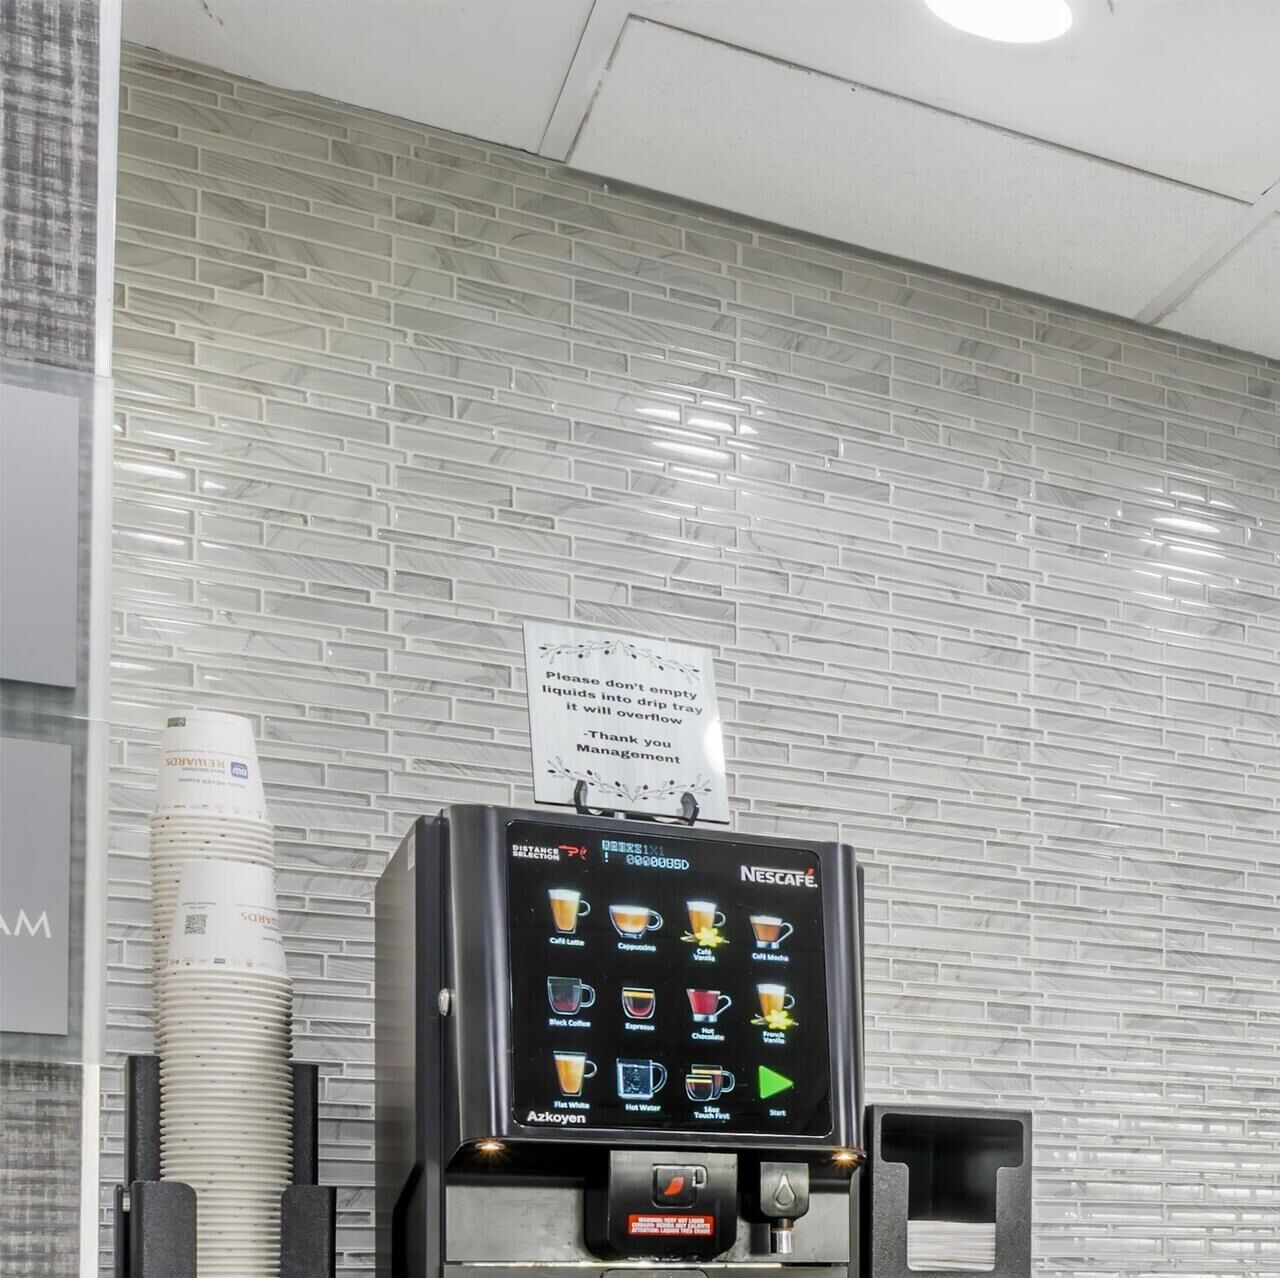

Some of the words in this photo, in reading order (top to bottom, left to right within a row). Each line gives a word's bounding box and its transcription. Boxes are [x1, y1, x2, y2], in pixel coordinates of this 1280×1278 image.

[545, 671, 600, 686] Please
[605, 679, 645, 692] don't
[649, 686, 698, 700] empty
[541, 684, 596, 699] liquids
[601, 691, 632, 704] into
[637, 697, 668, 711] drip
[672, 703, 703, 716] tray
[566, 702, 578, 711] it
[583, 704, 612, 716] will
[616, 709, 683, 725] overflow
[583, 731, 639, 745] -Thank
[643, 738, 672, 749] you
[576, 743, 681, 764] Management
[165, 757, 225, 769] REWARDS
[512, 844, 559, 855] DISTANCE
[512, 850, 560, 861] SELECTION
[549, 937, 564, 945] Café
[565, 938, 585, 946] Latte
[617, 942, 656, 952] Cappuccino
[693, 953, 715, 962] Vanilla
[752, 952, 767, 960] Café
[767, 953, 789, 962] Mocha
[549, 1018, 567, 1027] Black
[568, 1019, 591, 1028] Coffee
[625, 1022, 655, 1031] Espresso
[701, 1027, 715, 1035] Hot
[763, 1031, 785, 1039] French
[691, 1033, 725, 1041] Chocolate
[763, 1037, 785, 1045] Vanilla
[554, 1101, 568, 1109] Flat
[568, 1101, 590, 1110] White
[625, 1103, 639, 1111] Hot
[639, 1103, 662, 1112] Water
[527, 1110, 586, 1124] Azkoyen
[715, 1112, 730, 1120] First
[769, 1109, 786, 1117] Start
